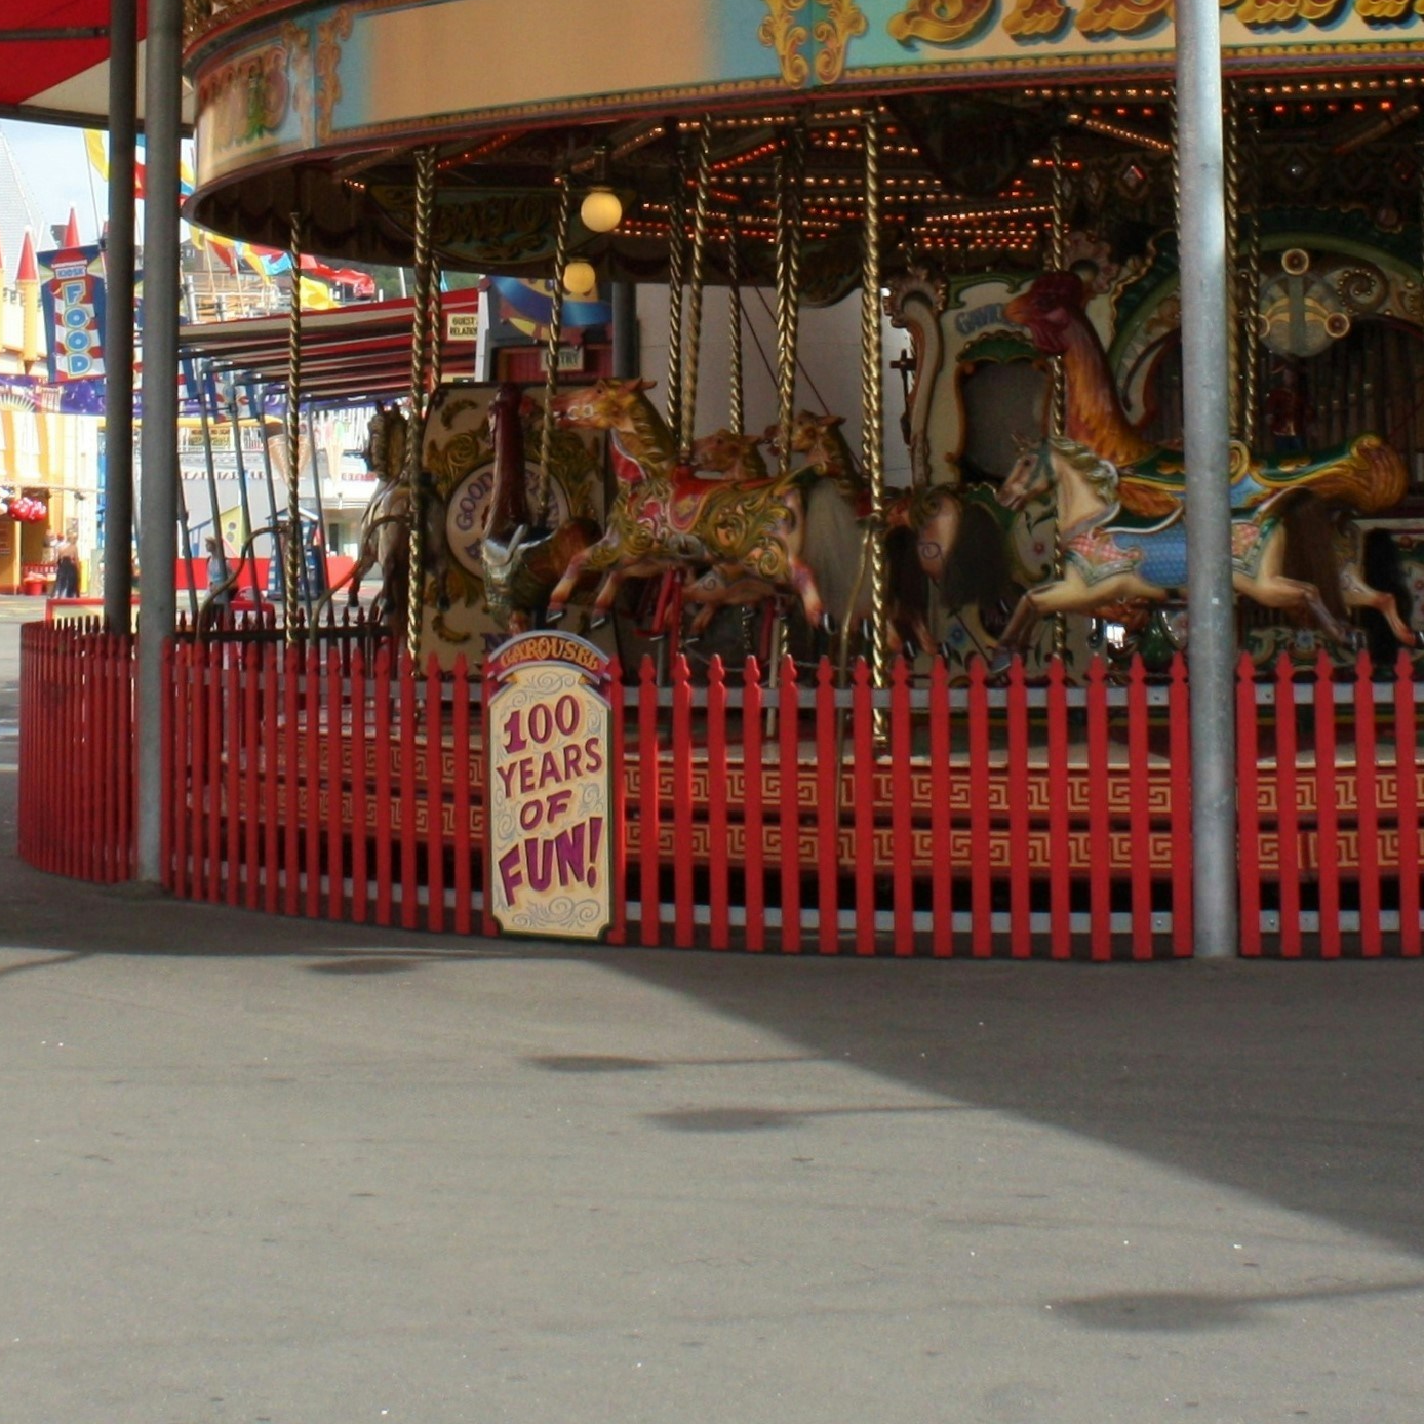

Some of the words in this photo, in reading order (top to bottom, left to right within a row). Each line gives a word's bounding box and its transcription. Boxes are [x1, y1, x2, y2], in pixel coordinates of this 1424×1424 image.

[63, 281, 91, 375] FOOD
[500, 635, 600, 671] CAROUSEL
[503, 694, 581, 755] 100
[496, 736, 603, 799] YEARS
[519, 788, 573, 831] OF
[497, 816, 604, 907] FUN!
